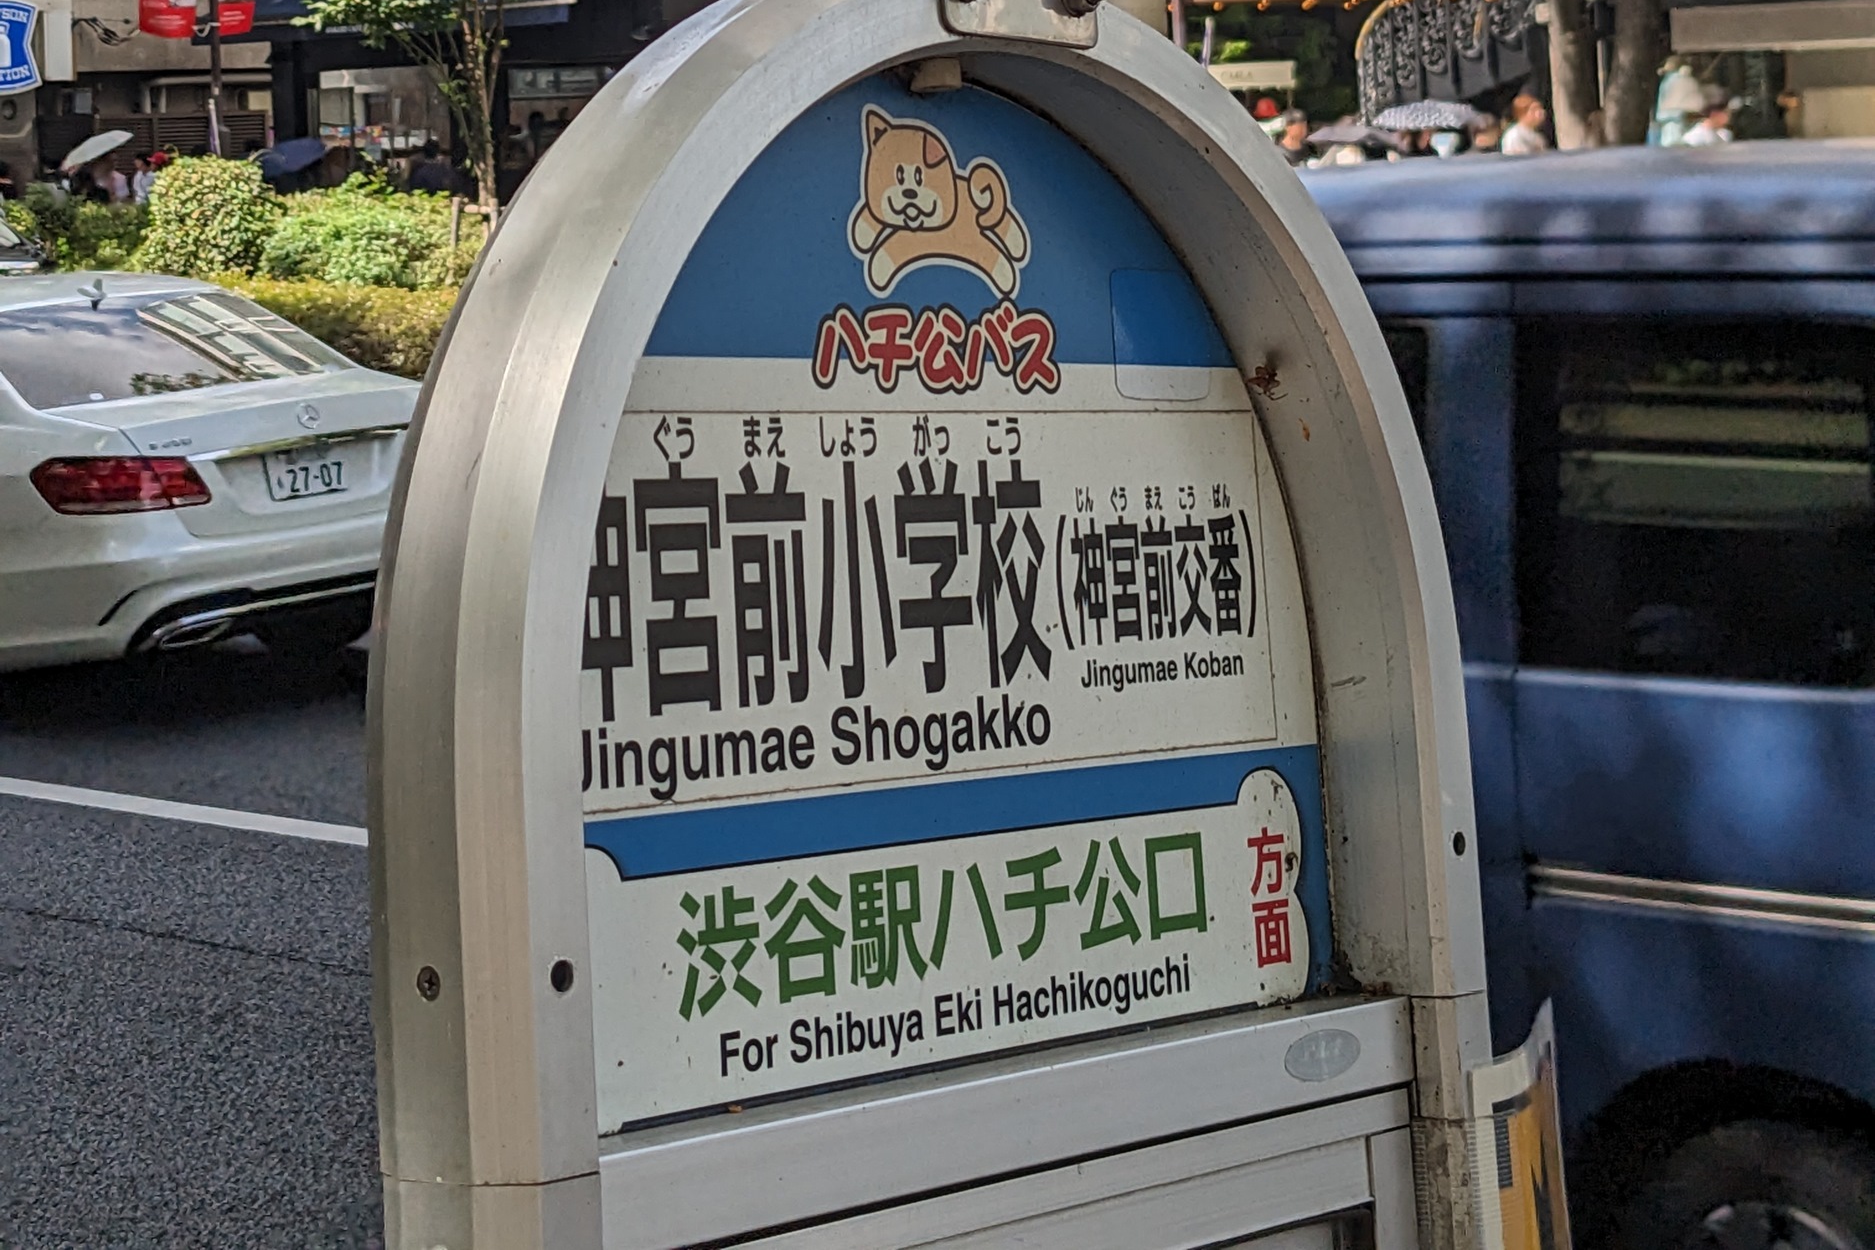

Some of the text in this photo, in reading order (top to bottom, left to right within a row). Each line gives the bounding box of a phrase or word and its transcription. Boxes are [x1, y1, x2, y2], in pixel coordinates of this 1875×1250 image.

[812, 301, 1061, 395] ハチ公バス
[285, 461, 342, 493] 27-07
[653, 414, 1021, 461] ぐう まえ しょう がっ こう
[1081, 650, 1244, 693] Jingumae Koban
[582, 694, 1051, 802] Jingumae Shogakko
[677, 831, 1208, 1022] 渋谷駅ハチ公口
[1247, 827, 1292, 969] 方面
[719, 953, 1191, 1077] For Shibuya Eki Hachikoguchi
